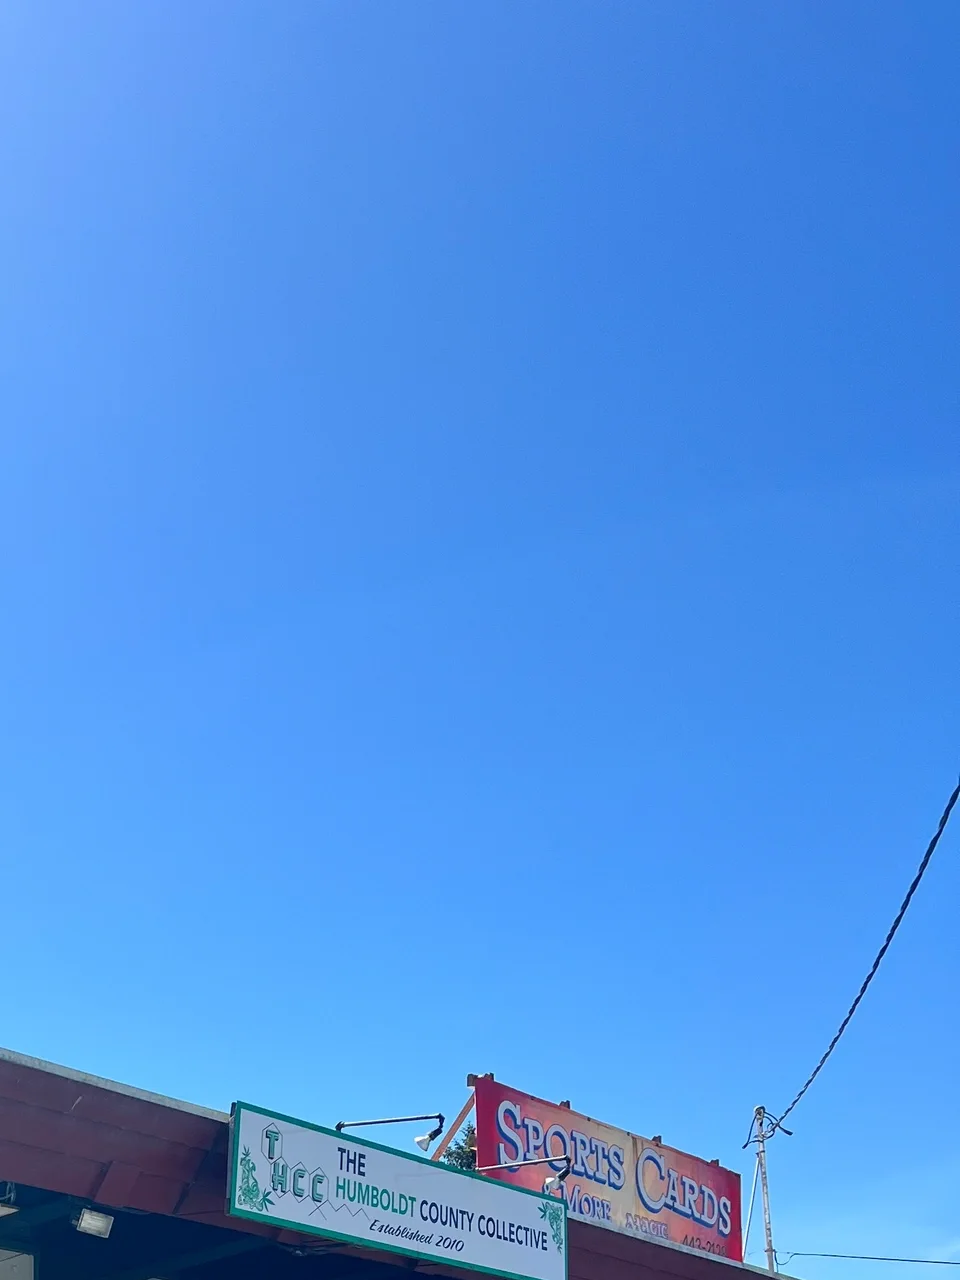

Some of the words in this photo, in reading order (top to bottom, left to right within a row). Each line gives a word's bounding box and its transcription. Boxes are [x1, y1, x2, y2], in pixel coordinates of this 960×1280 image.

[337, 1146, 367, 1177] THE
[335, 1181, 417, 1218] HUMBOLDT
[420, 1199, 474, 1233] COUNTY
[478, 1214, 548, 1251] COLLECTIVE
[369, 1219, 434, 1245] Established
[435, 1234, 465, 1253] 2010
